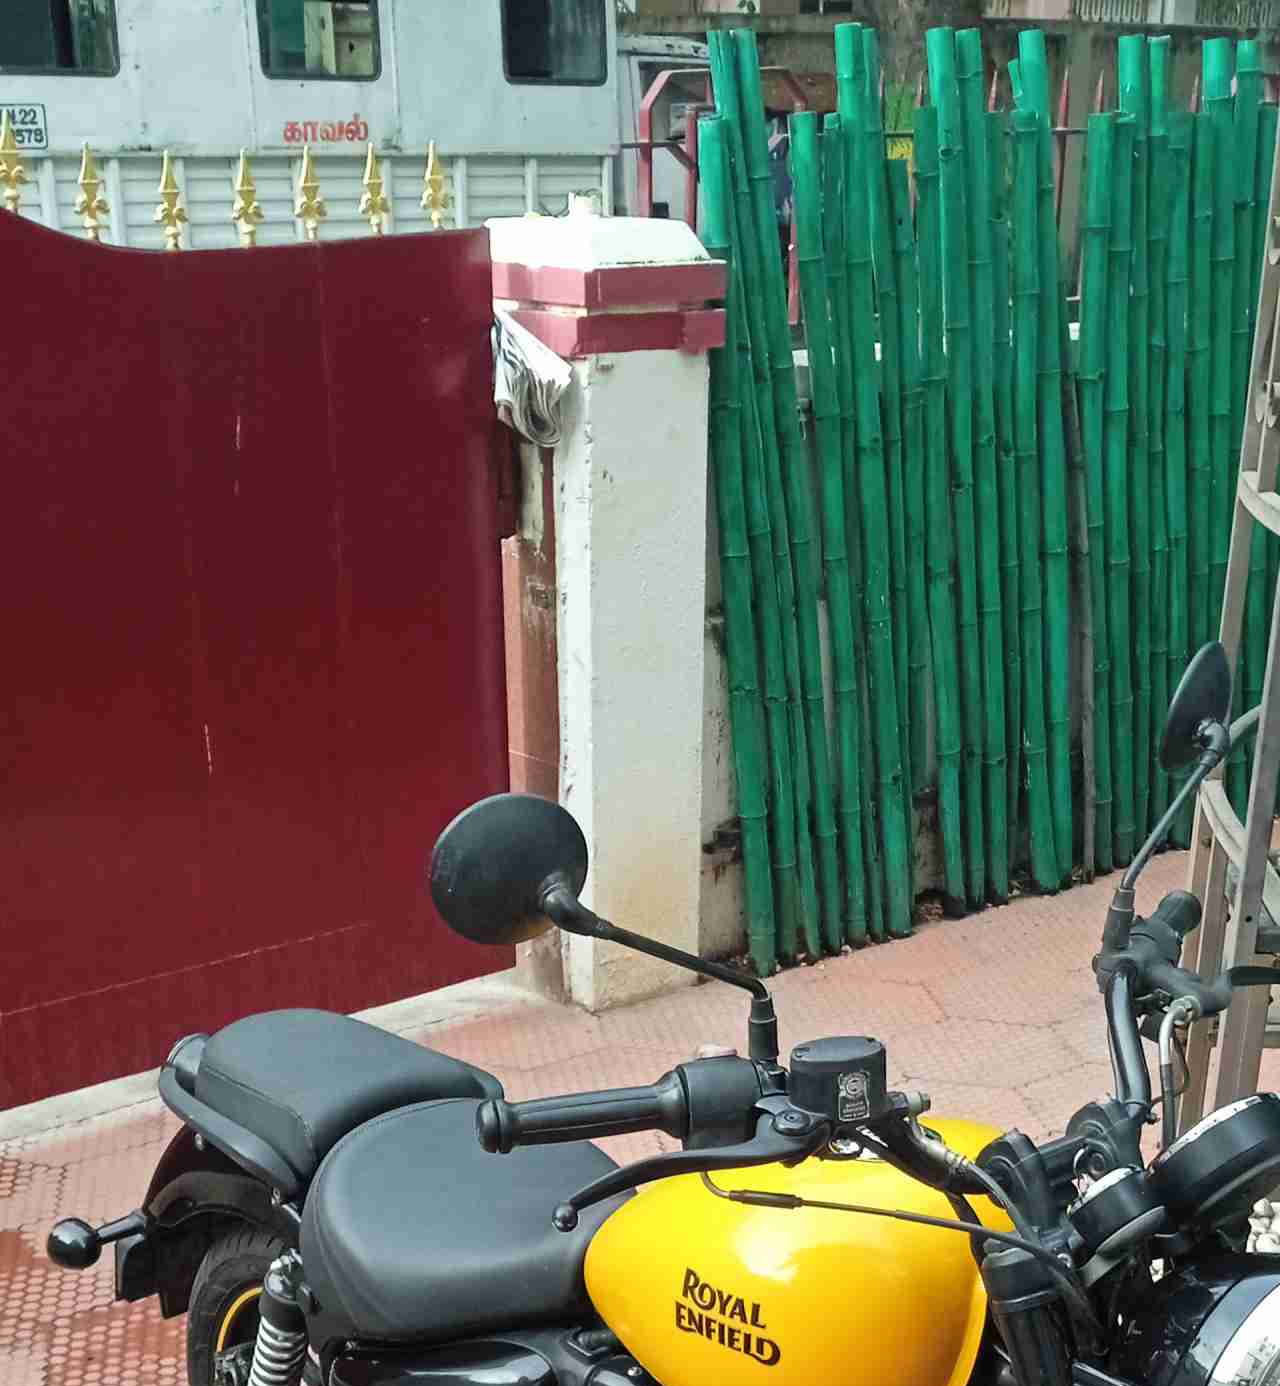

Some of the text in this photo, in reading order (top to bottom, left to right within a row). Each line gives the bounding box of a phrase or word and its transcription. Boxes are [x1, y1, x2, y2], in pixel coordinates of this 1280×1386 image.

[283, 112, 369, 143] காவல்
[682, 1267, 766, 1329] ROYAL
[675, 1301, 781, 1366] ENFIELD
